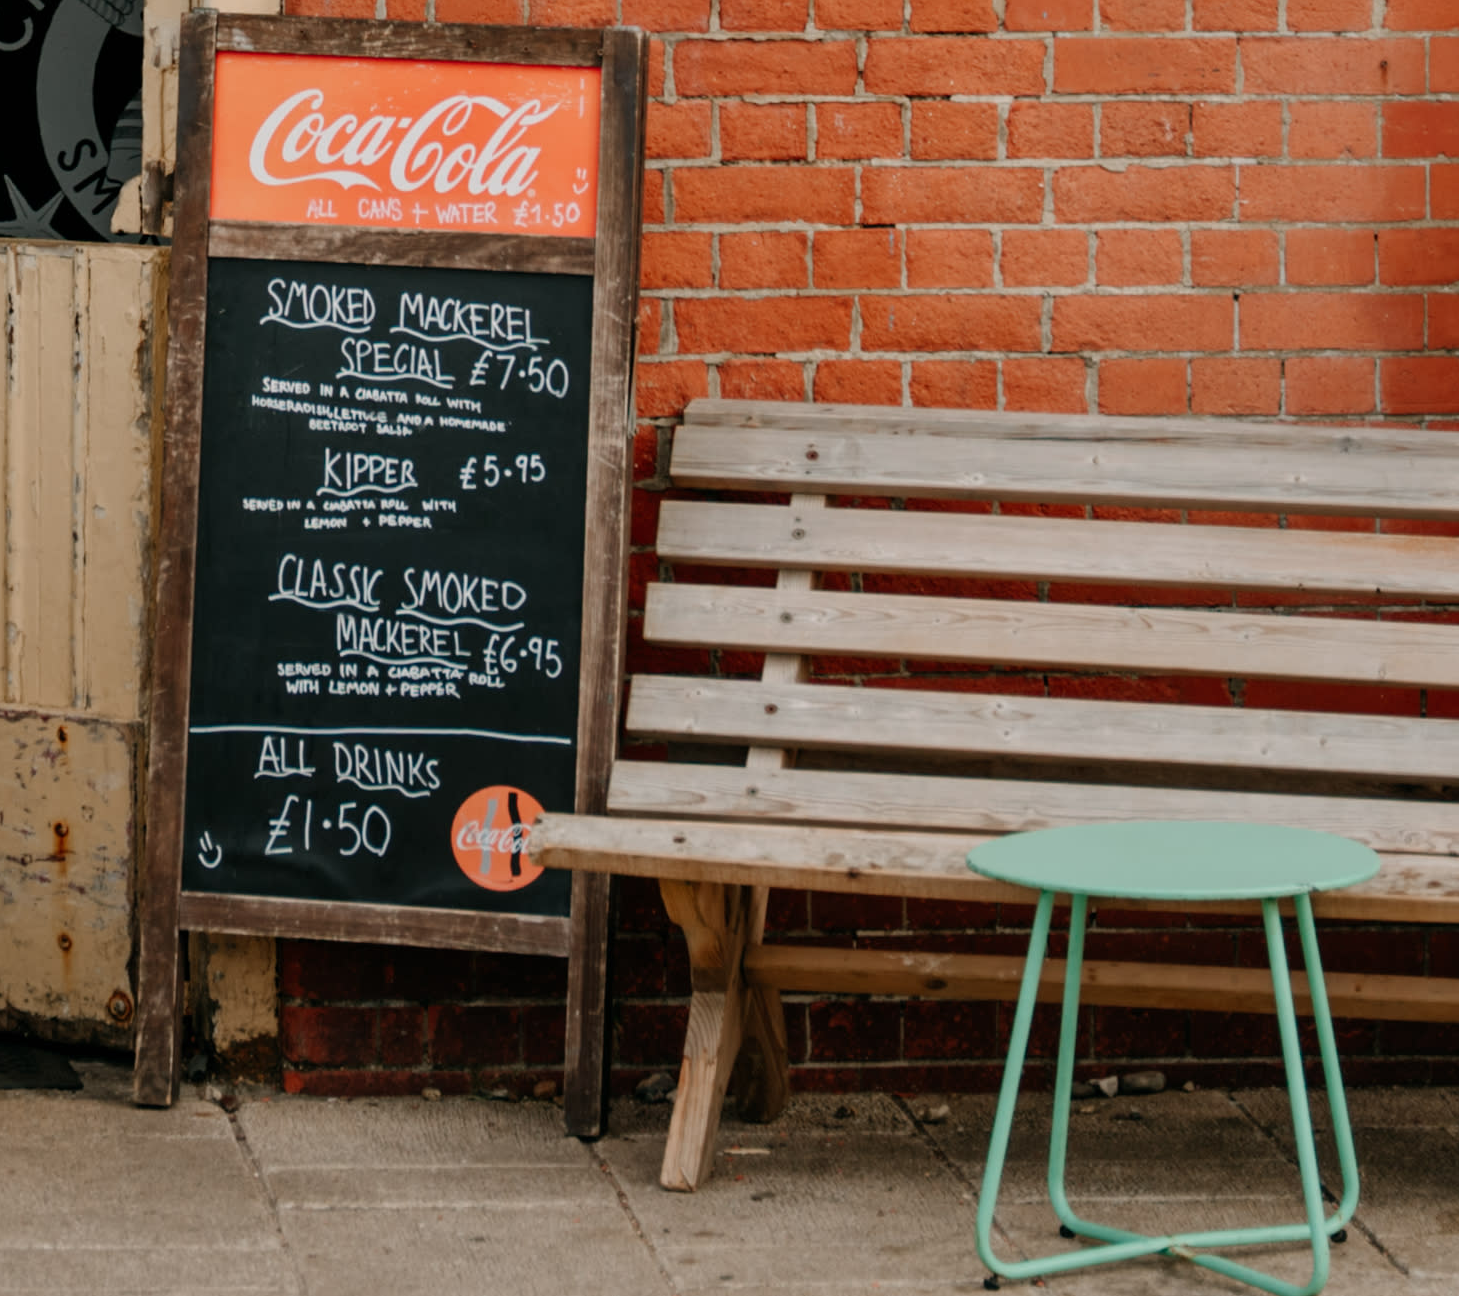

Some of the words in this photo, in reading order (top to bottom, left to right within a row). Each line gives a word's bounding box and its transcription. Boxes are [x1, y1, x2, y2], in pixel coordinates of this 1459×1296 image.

[249, 89, 560, 197] Coca-Cola
[307, 199, 337, 218] ALL
[358, 198, 403, 221] CANS
[436, 202, 498, 225] WATER
[512, 201, 580, 227] £1.50
[267, 278, 376, 325] SMOKED
[399, 291, 550, 345] MACKEREL
[262, 376, 311, 394] SERVED
[447, 397, 482, 413] WITH
[340, 337, 455, 381] SPECIAL
[469, 350, 569, 399] £7.50
[324, 447, 418, 490] KIPPER
[460, 455, 546, 489] £5.95
[278, 553, 381, 606] CLASSIC
[402, 568, 526, 612] SMOKED
[337, 614, 471, 658] MACKEREL
[483, 633, 562, 679] £6.95
[329, 680, 379, 695] LEMON
[400, 682, 460, 699] PEPPER
[256, 737, 315, 775] ALL
[334, 743, 440, 790] DRINKS
[265, 795, 390, 857] £1.50
[456, 821, 535, 855] Coca-Col
